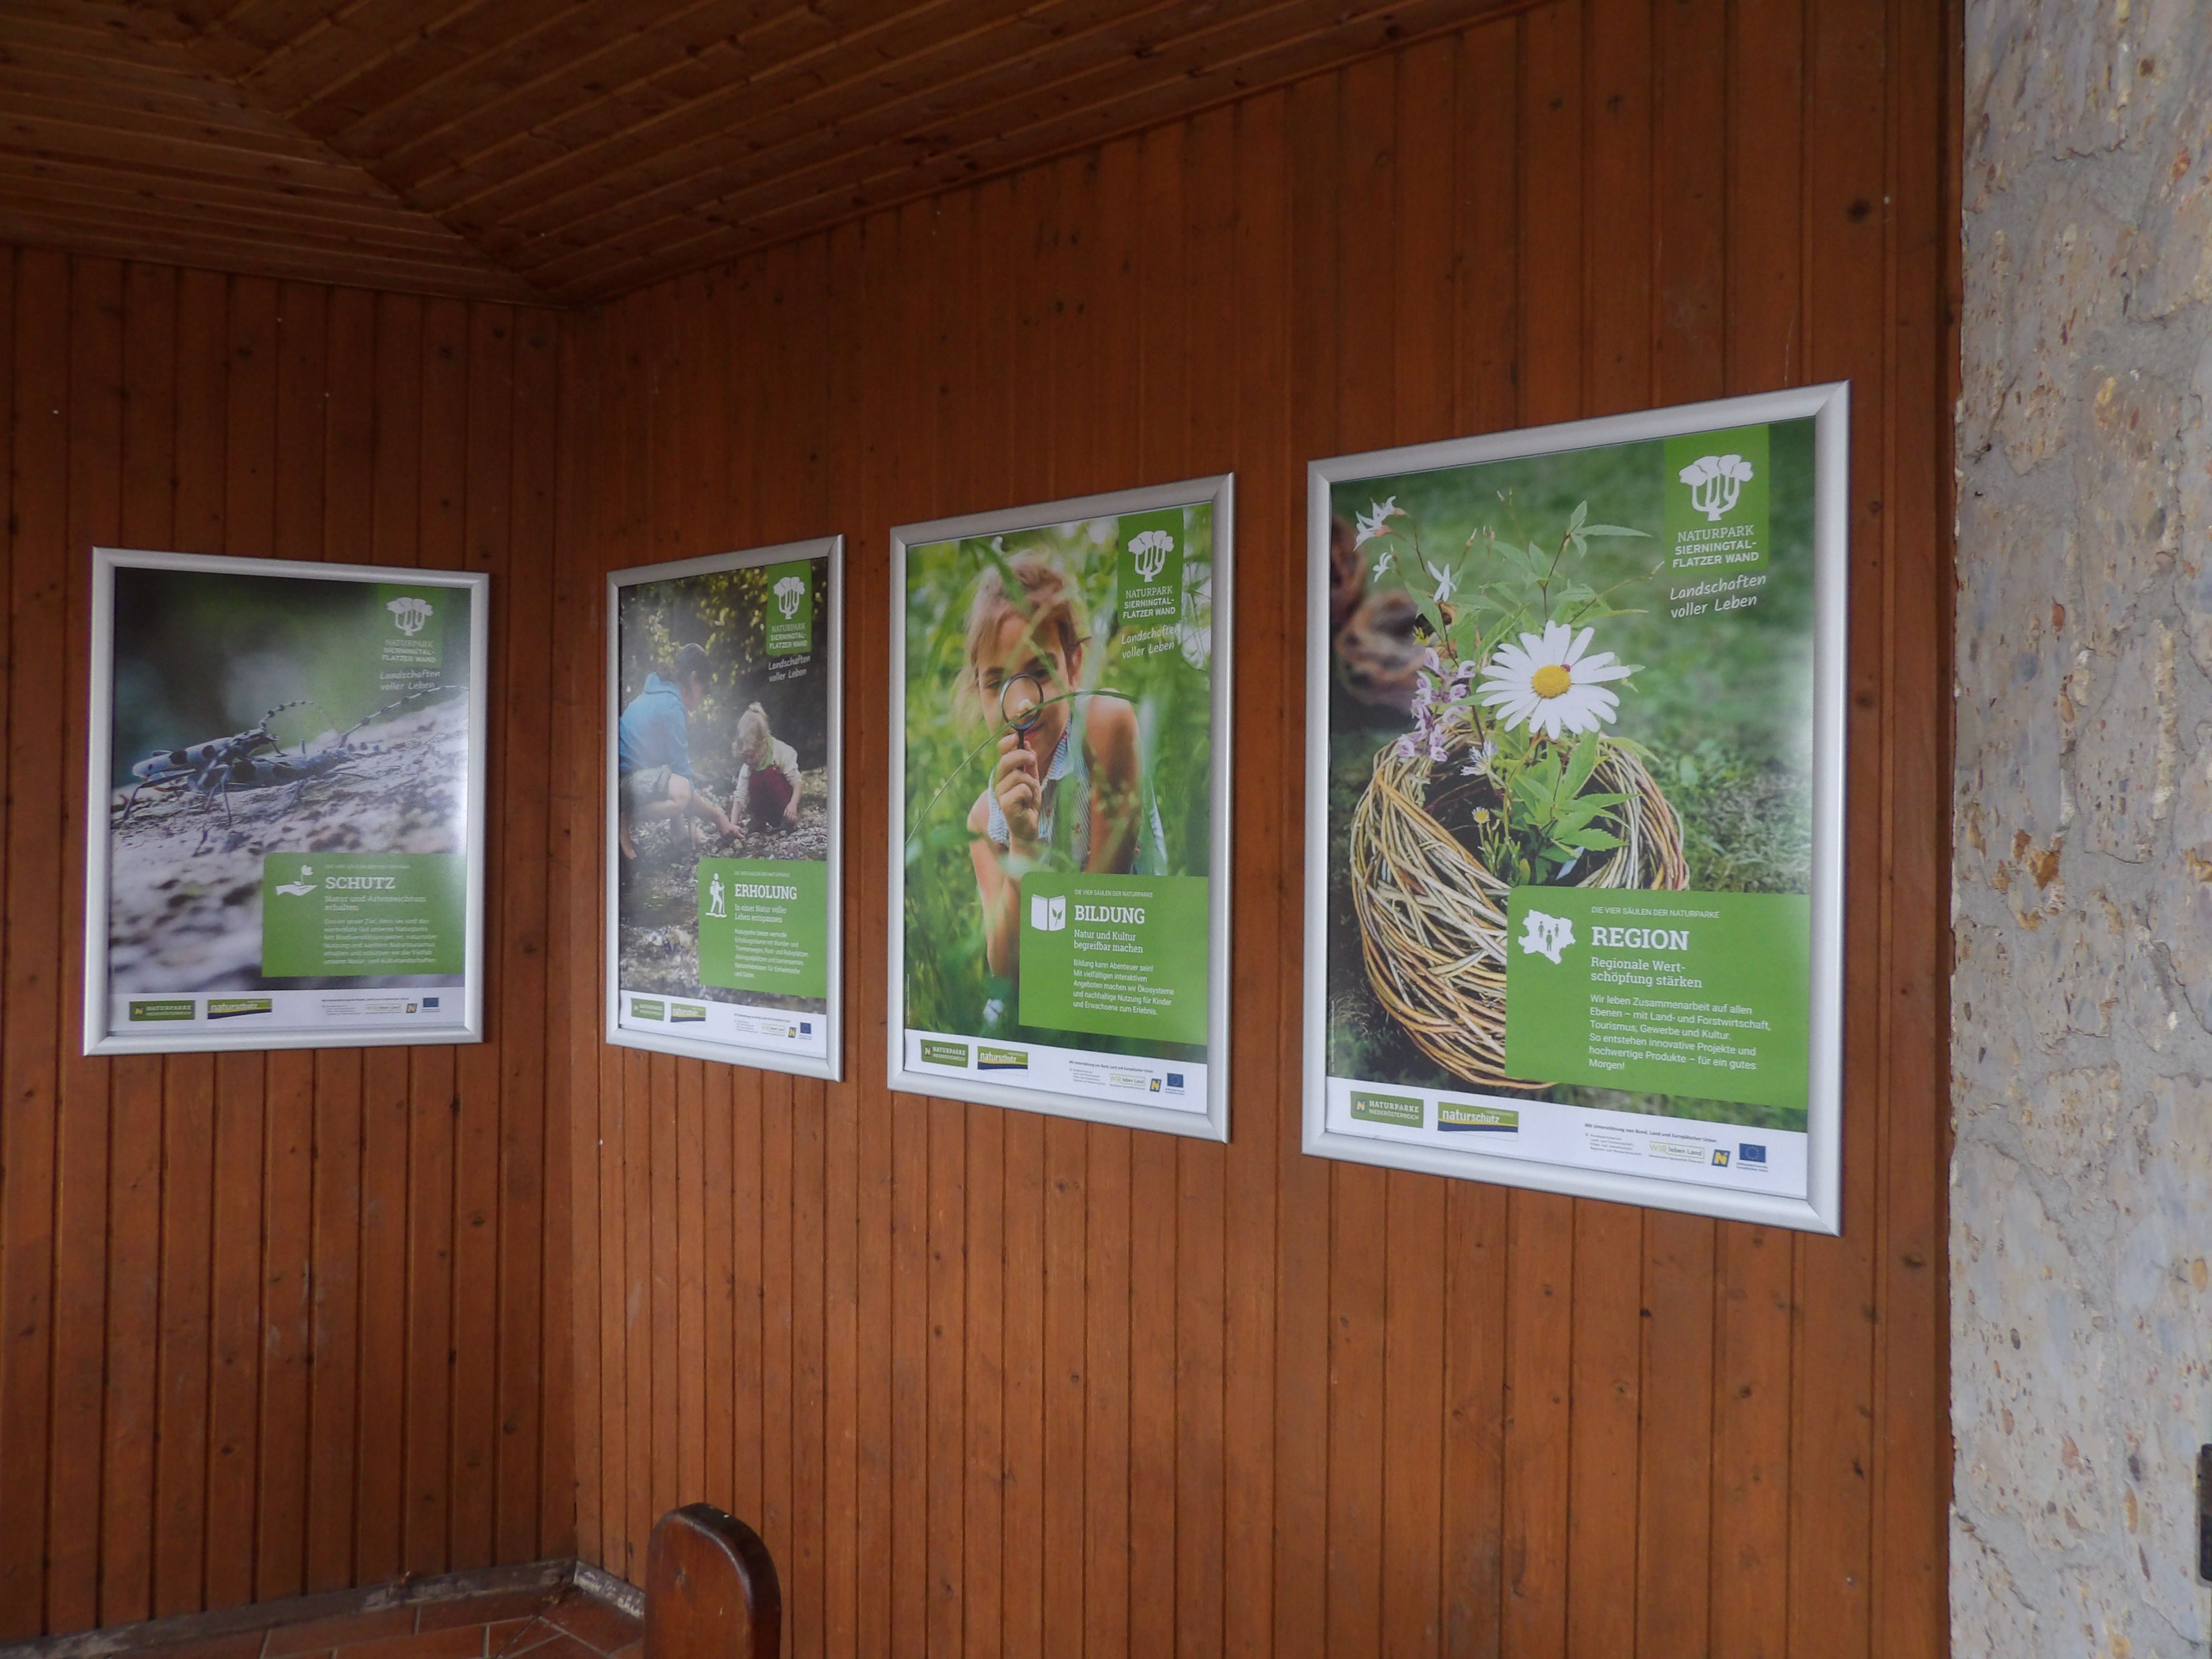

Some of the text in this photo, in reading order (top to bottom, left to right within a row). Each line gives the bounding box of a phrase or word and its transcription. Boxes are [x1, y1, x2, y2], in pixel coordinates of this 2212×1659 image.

[1677, 525, 1754, 542] NATURPARK
[1675, 541, 1757, 555] SIERNINGTAL-
[1673, 552, 1759, 568] FLATZER WAND
[1125, 585, 1173, 599] NATURPARK
[1670, 574, 1767, 601] Landschaften
[1124, 598, 1175, 609] SIERNINGTAL-
[1671, 595, 1757, 618] voller Leben
[1123, 606, 1176, 619] FLATZER WAND
[1121, 624, 1180, 645] Landschaften
[1122, 641, 1175, 659] voller Leben
[325, 877, 396, 889] SCHUTZ
[734, 884, 797, 900] ERHOLUNG
[1075, 905, 1145, 924] BILDUNG
[1669, 910, 1720, 918] NATURPARKE
[1074, 929, 1136, 941] Natur und Kultur
[1591, 926, 1689, 950] REGION
[1074, 940, 1143, 953] begreifbar machen
[1074, 959, 1094, 968] Bildung
[1110, 962, 1138, 970] Abenteuer
[1591, 957, 1686, 972] Regionale Wert-
[1114, 974, 1147, 982] interaktiven
[1590, 971, 1703, 988] schöpfung stärken
[1074, 980, 1103, 989] Angeboten
[1104, 983, 1126, 991] machen
[1138, 985, 1174, 995] Ökosysteme
[1084, 992, 1116, 1001] nachhaltige
[1118, 995, 1142, 1004] Nutzung
[1590, 994, 1753, 1014] Wir leben Zusammenarbeit auf allen
[1084, 1001, 1118, 1011] Erwachsene
[1590, 1007, 1623, 1018] Ebenen
[1633, 1011, 1648, 1020] mit
[1650, 1012, 1675, 1022] Land-
[1677, 1014, 1695, 1024] und
[1697, 1015, 1772, 1031] Forstwirtschaft,
[1590, 1020, 1731, 1041] Tourismus, Gewerbe und Kultur.
[933, 1046, 966, 1056] NATURPARKE
[1589, 1033, 1756, 1056] So entstehen innovative Projekte und
[980, 1052, 1017, 1062] naturschutz
[1589, 1046, 1643, 1060] hochwertige
[1645, 1051, 1687, 1063] Produkte
[1698, 1056, 1711, 1065] für
[1713, 1058, 1727, 1067] ein
[1729, 1060, 1756, 1070] gutes
[1589, 1058, 1625, 1071] Morgen!
[1369, 1100, 1419, 1113] NATURPARKE
[1369, 1108, 1419, 1120] NIEDERÖSTERREICH
[1442, 1109, 1500, 1123] naturschutz
[1649, 1144, 1667, 1153] WIR
